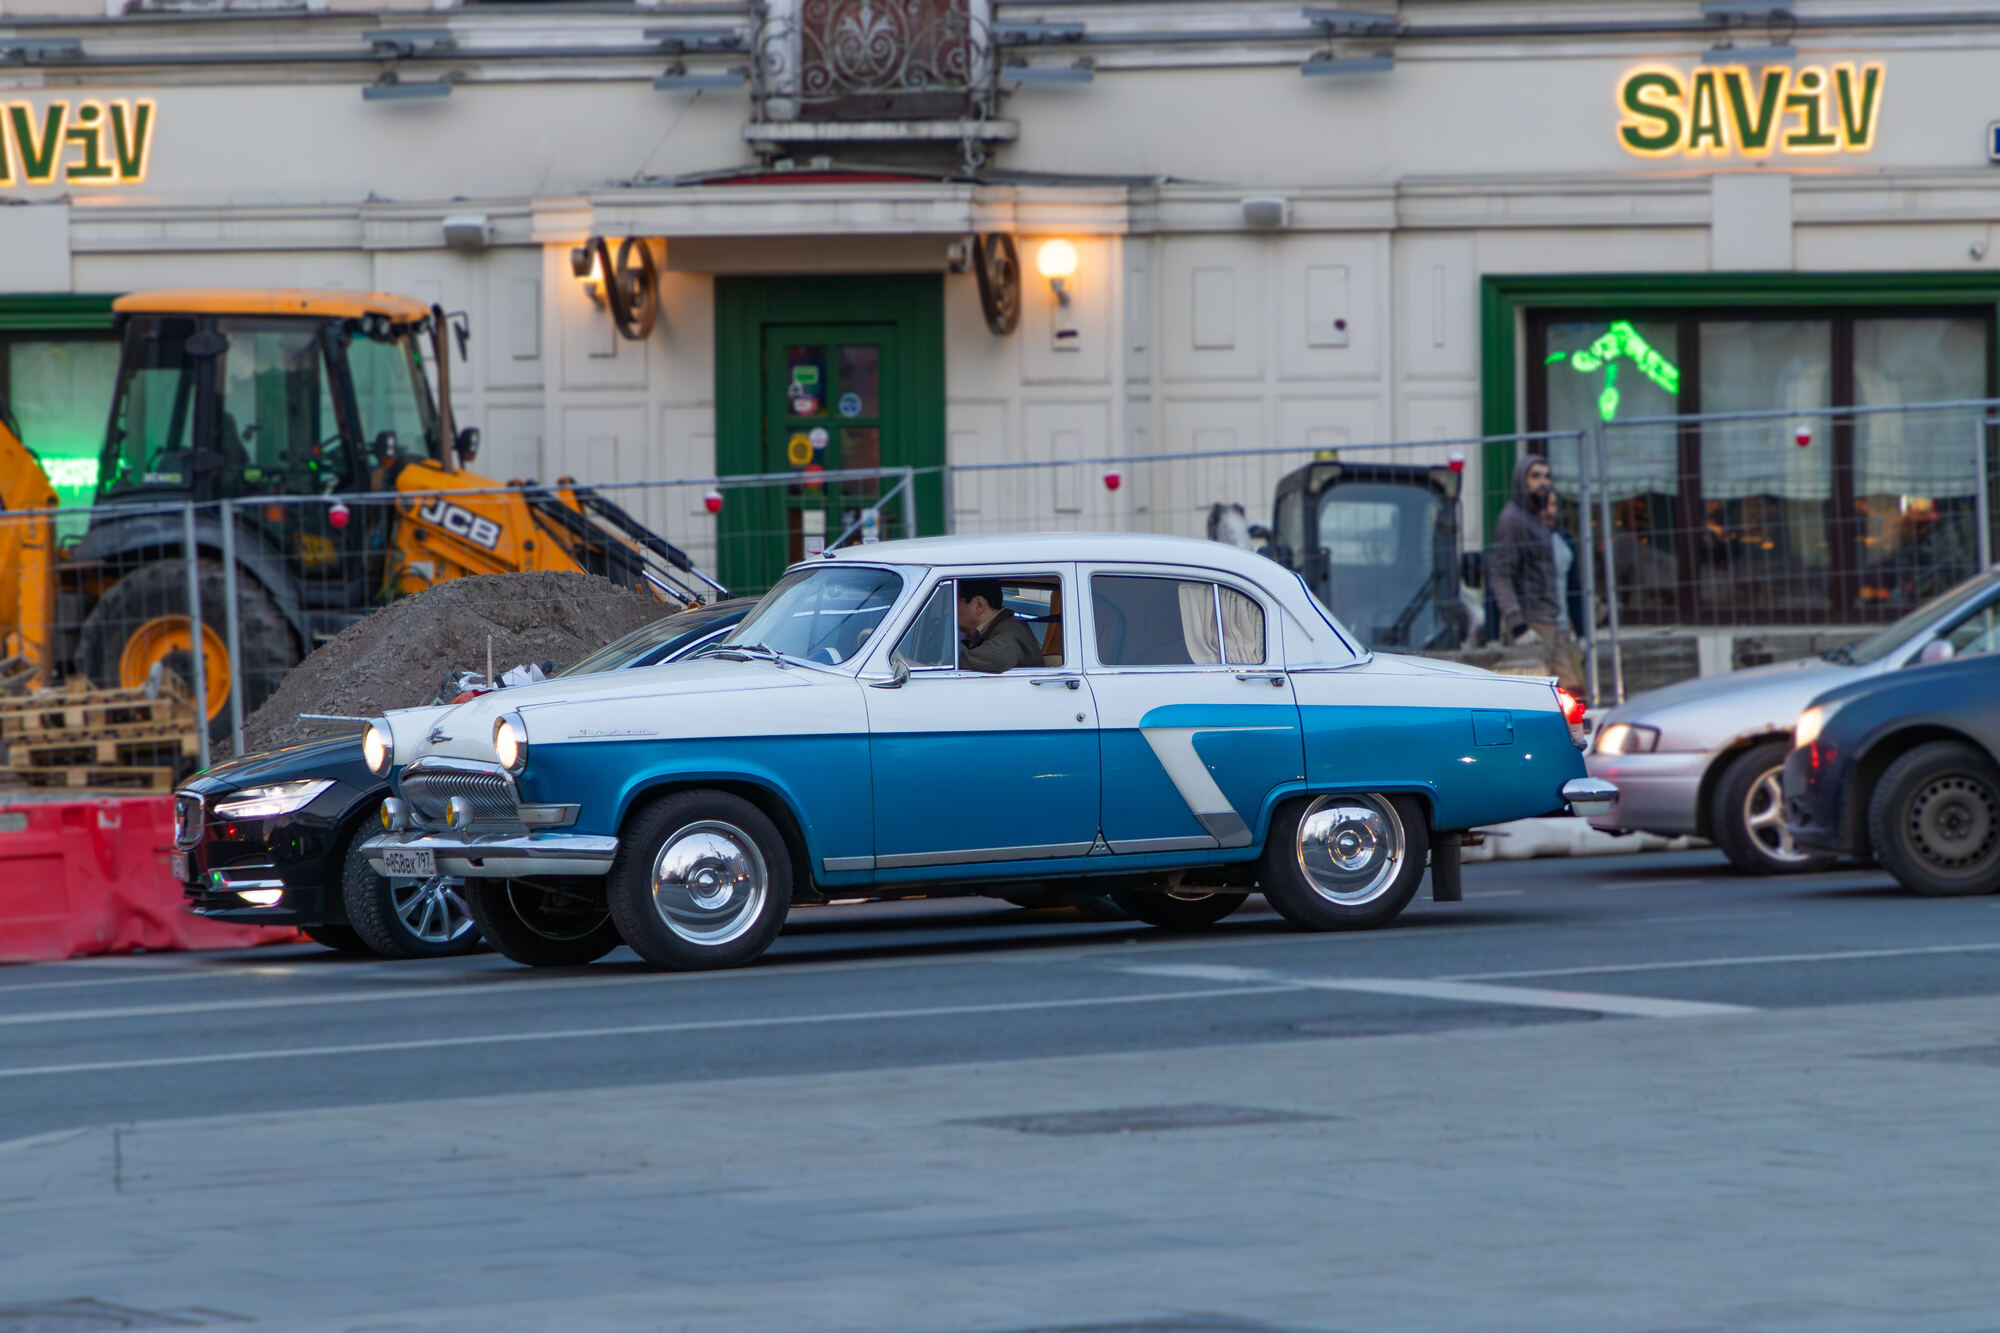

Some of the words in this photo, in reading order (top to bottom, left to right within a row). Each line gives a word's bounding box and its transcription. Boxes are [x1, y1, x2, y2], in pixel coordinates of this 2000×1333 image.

[0, 101, 152, 181] ViV
[1619, 66, 1881, 151] SAViV
[420, 499, 501, 549] JCB
